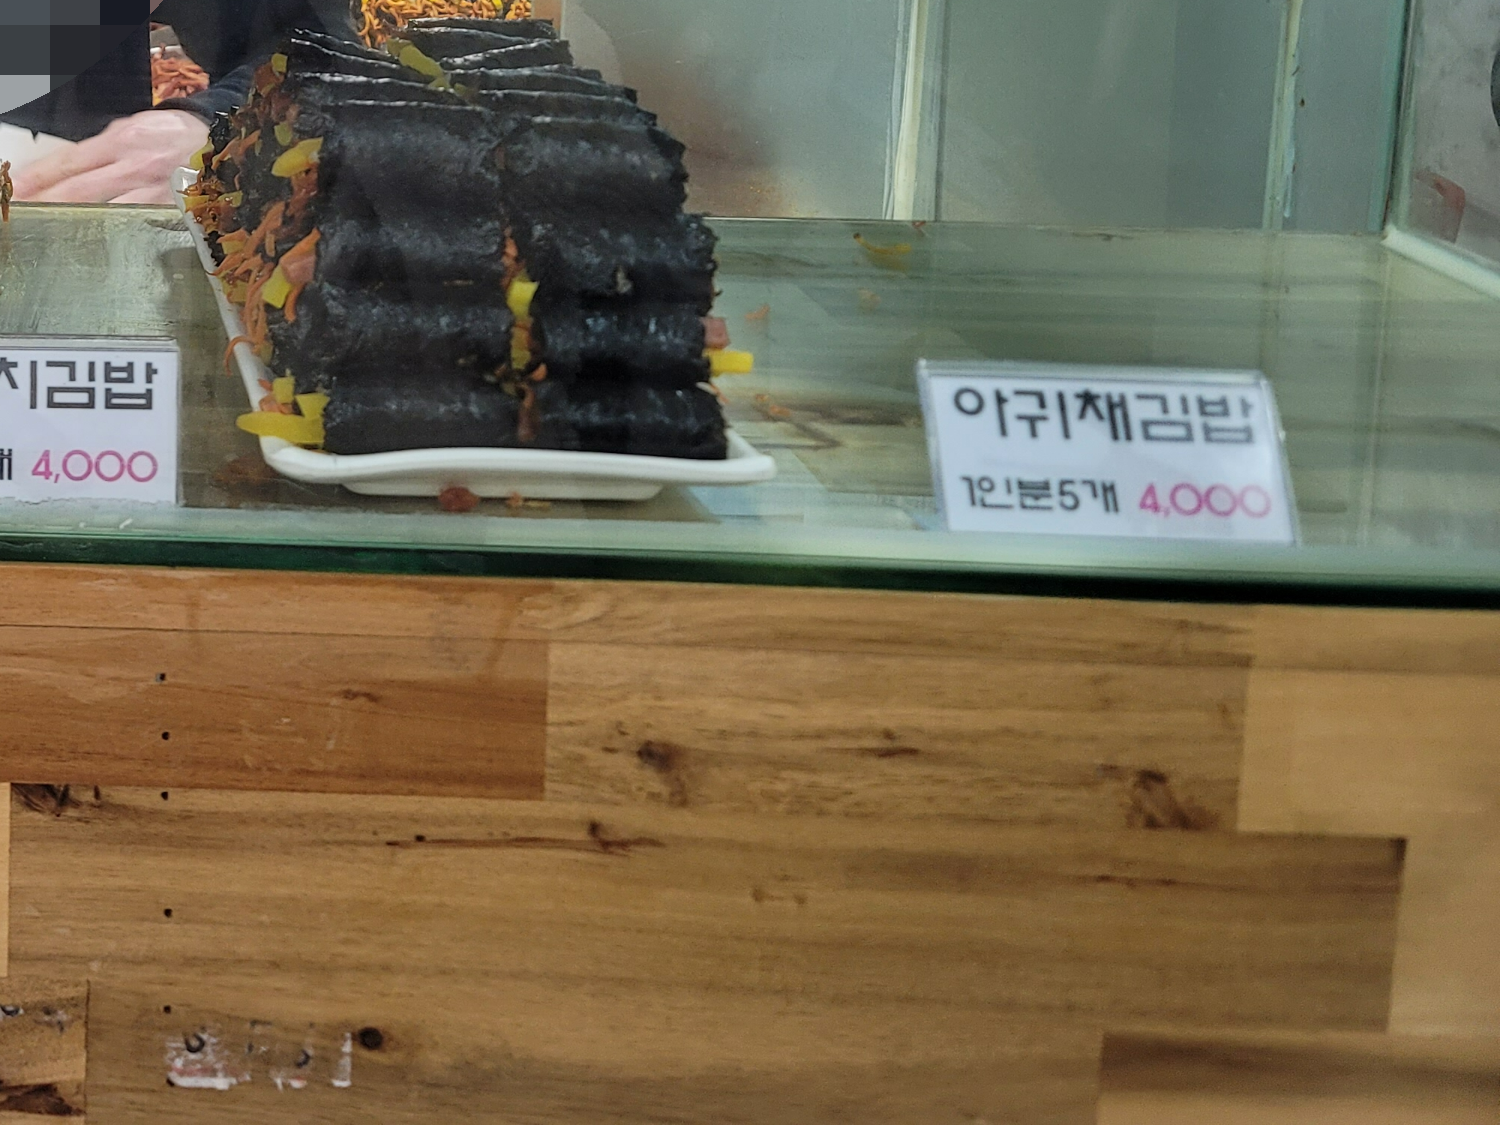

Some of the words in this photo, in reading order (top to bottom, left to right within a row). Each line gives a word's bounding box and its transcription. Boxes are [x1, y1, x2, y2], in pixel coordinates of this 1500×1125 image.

[952, 386, 1255, 445] 아귀채김밥
[31, 449, 160, 484] 4,000
[1138, 482, 1273, 519] 4,000
